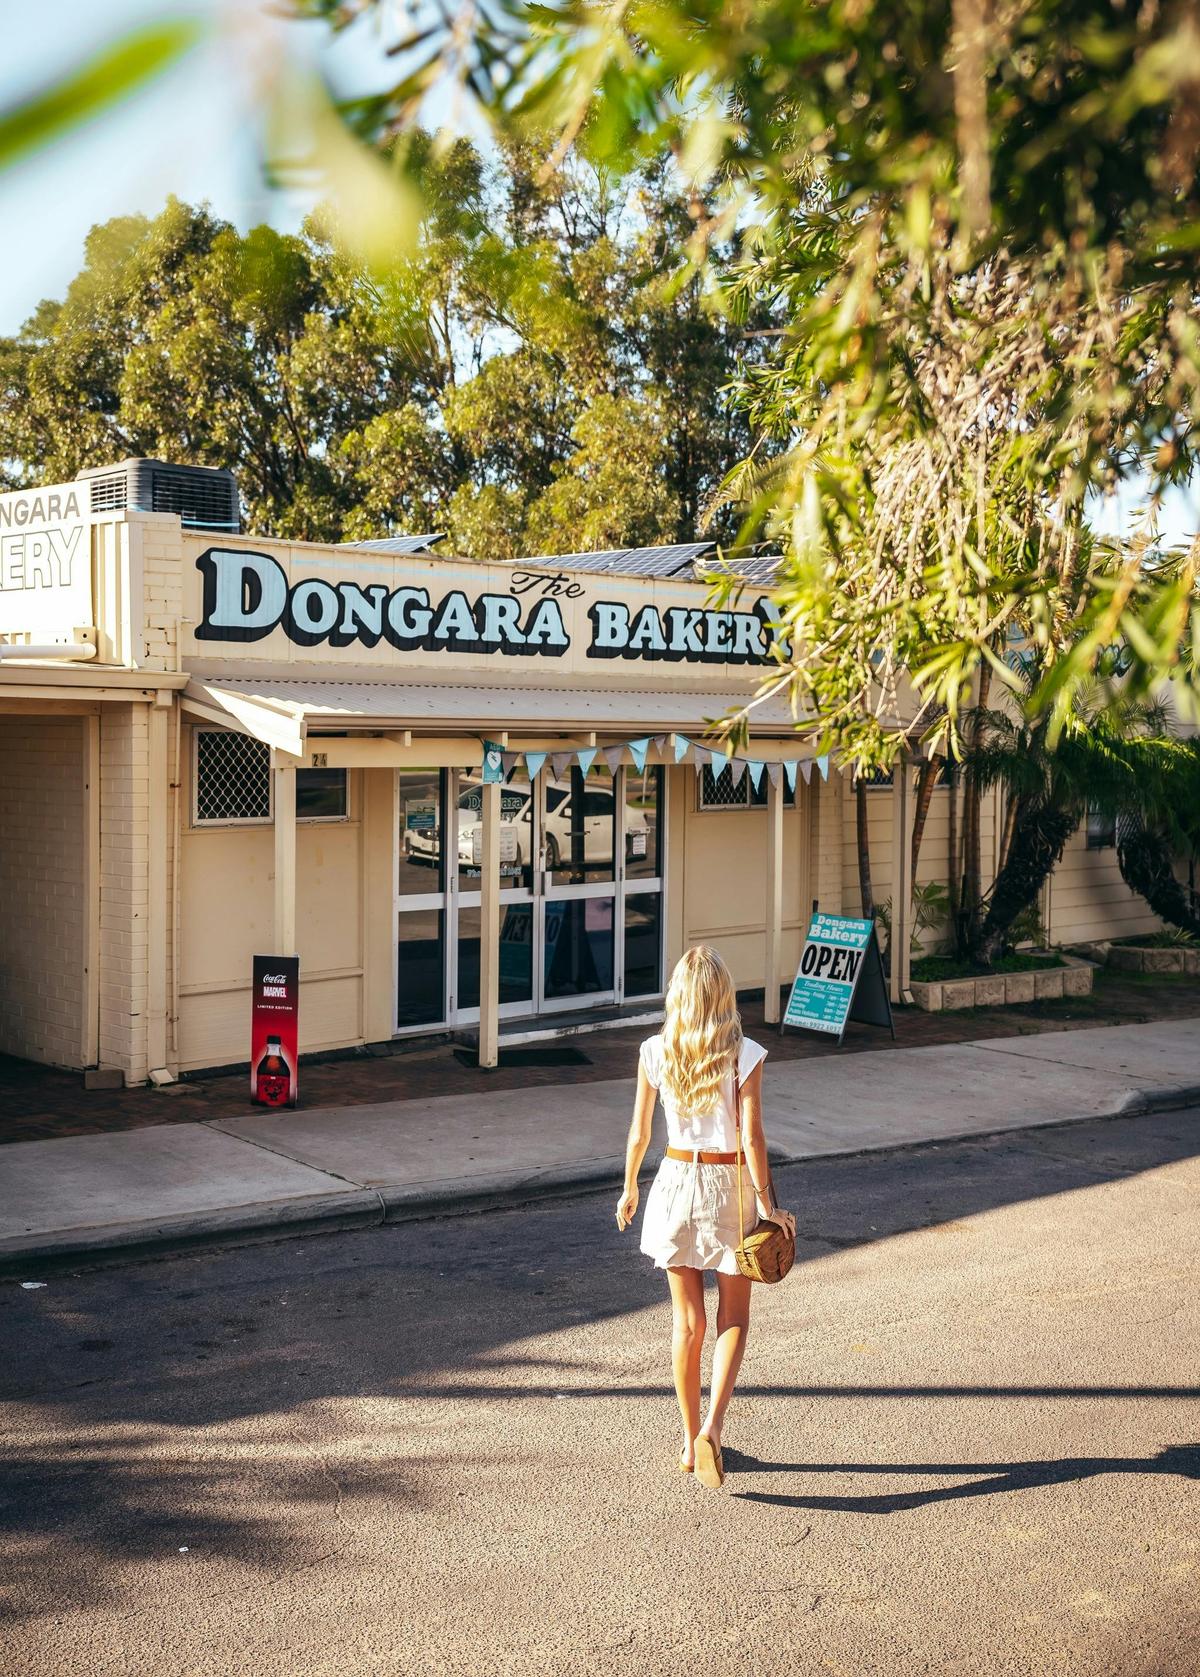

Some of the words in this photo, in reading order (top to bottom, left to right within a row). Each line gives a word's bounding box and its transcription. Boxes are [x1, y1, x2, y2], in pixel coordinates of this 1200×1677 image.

[0, 525, 84, 592] ERY
[509, 572, 586, 599] The
[195, 547, 570, 657] DONGARA
[468, 795, 523, 812] Dara
[816, 915, 866, 930] Dongara
[808, 924, 868, 946] Bakery
[801, 944, 862, 982] OPEN
[263, 986, 287, 998] MARVEL
